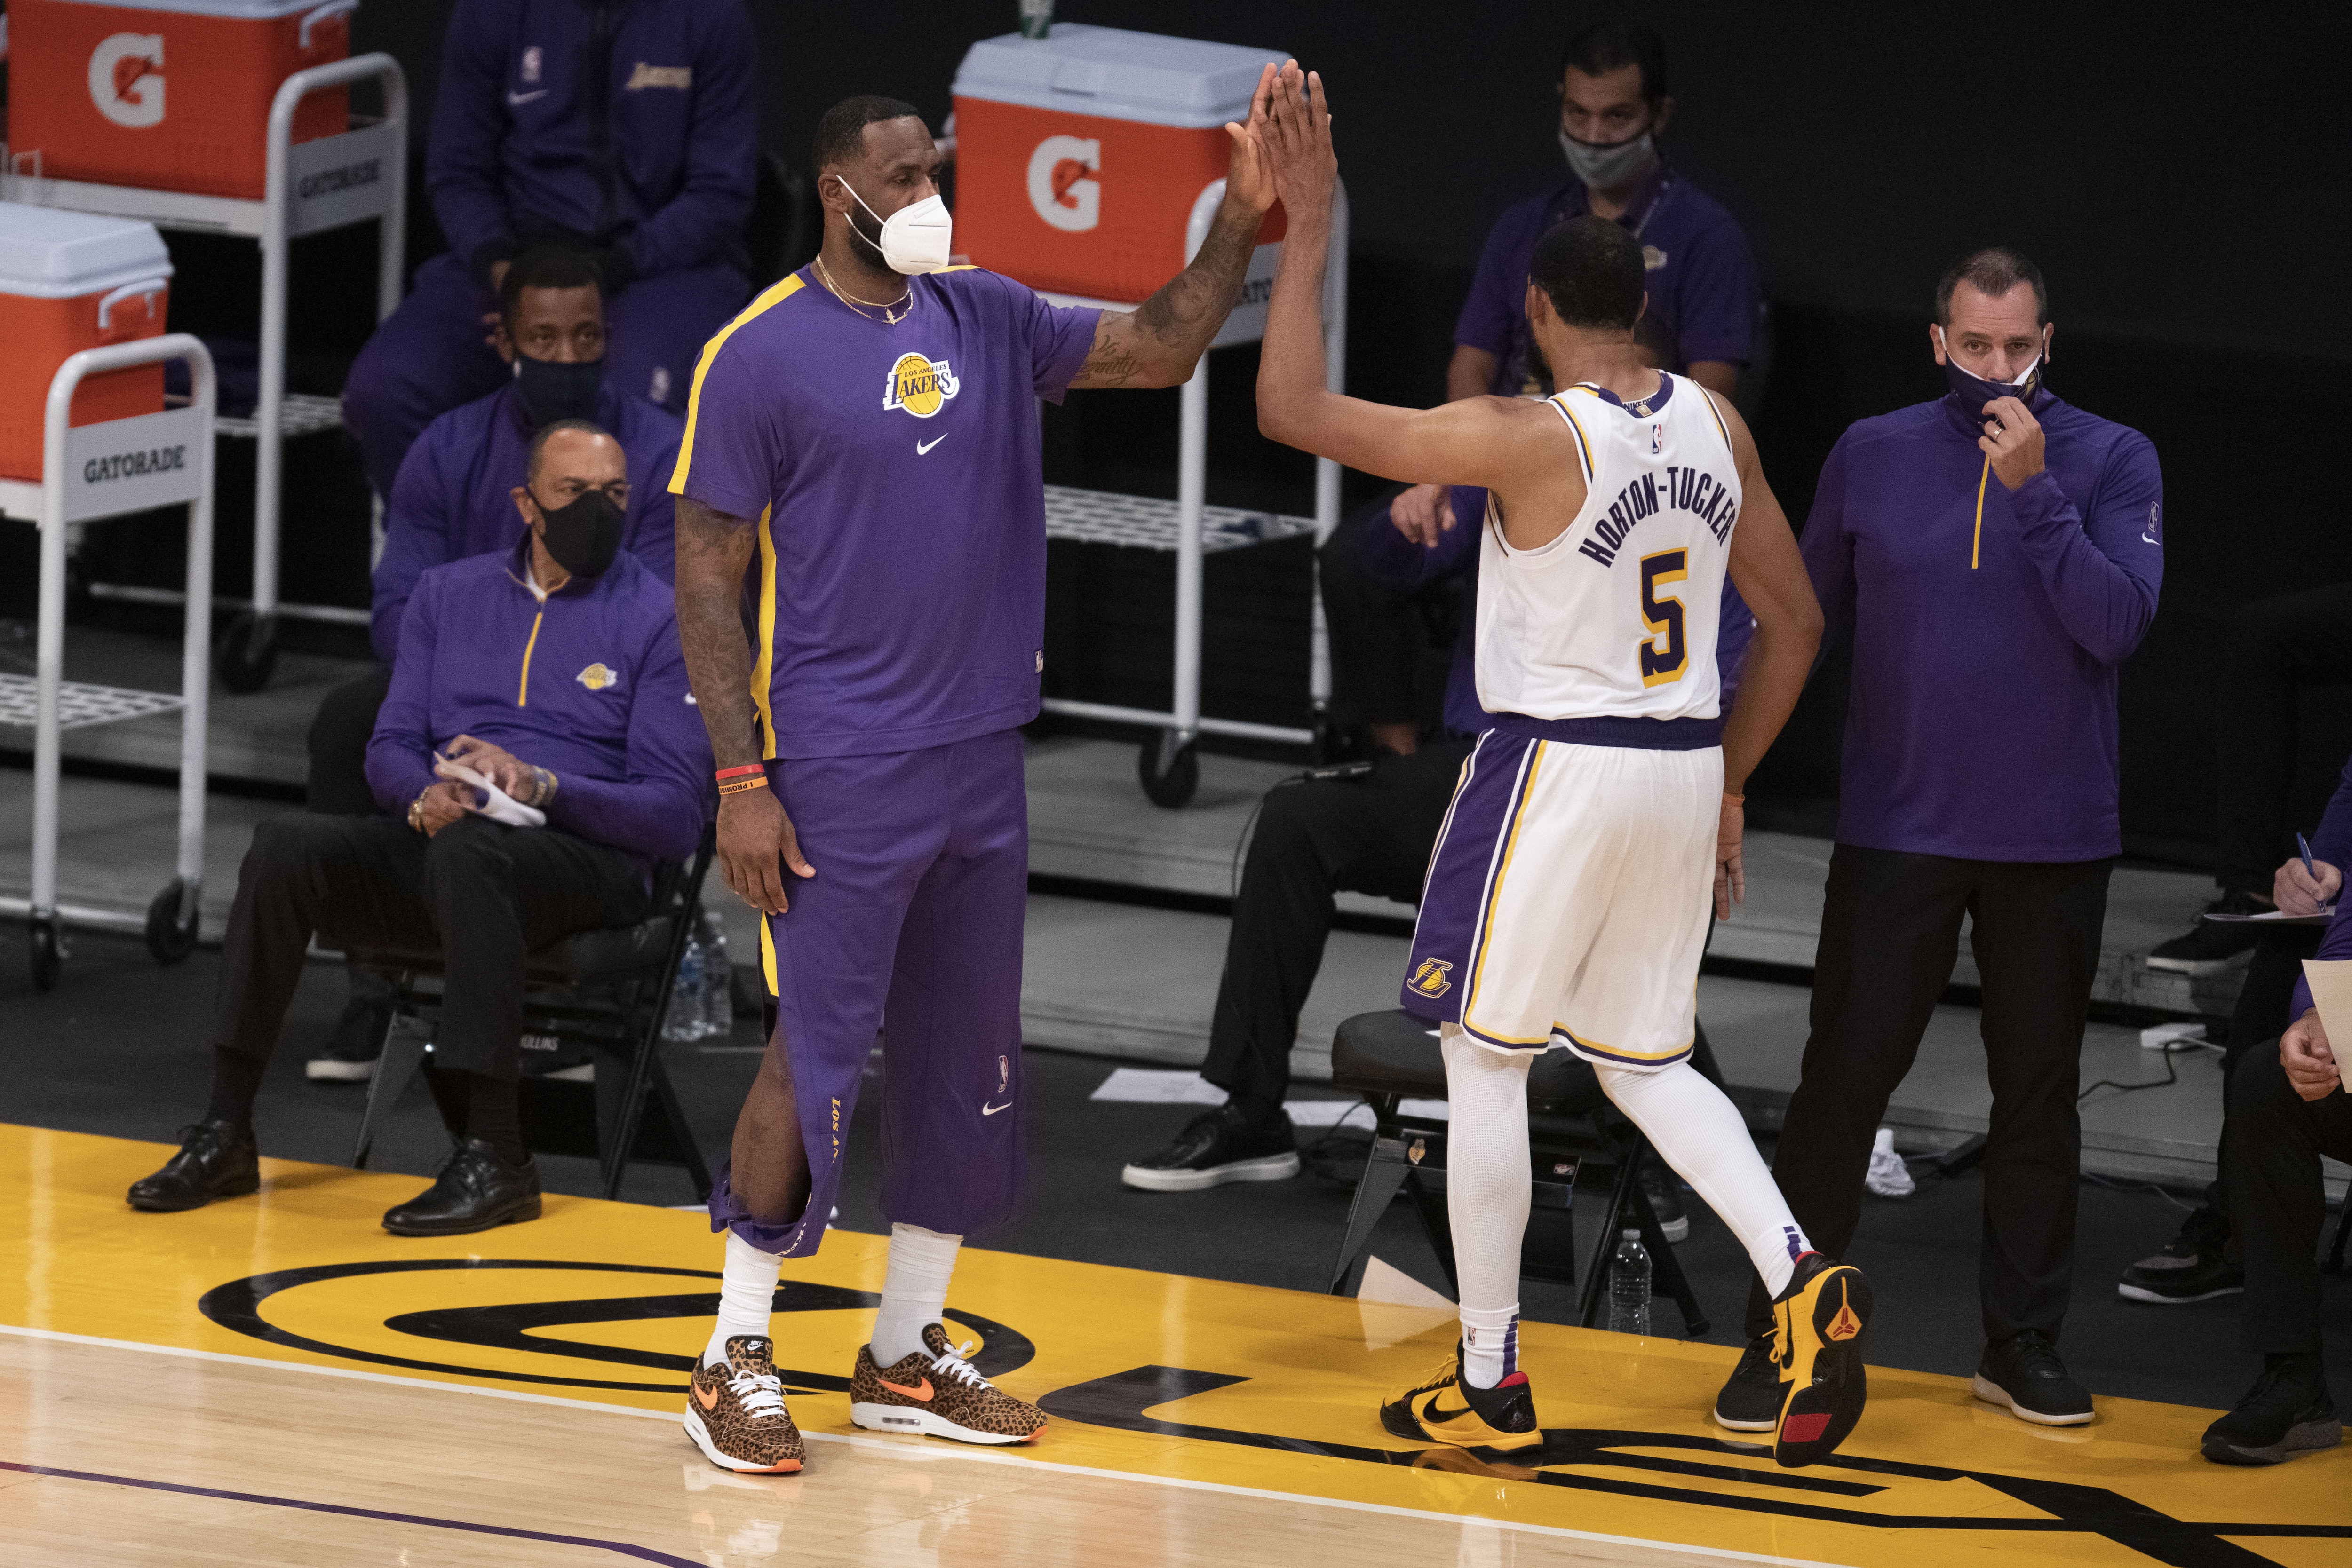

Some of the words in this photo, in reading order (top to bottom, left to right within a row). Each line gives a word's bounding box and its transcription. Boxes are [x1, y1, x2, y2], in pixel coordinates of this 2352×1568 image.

[88, 32, 165, 127] G
[1027, 135, 1100, 232] G
[888, 372, 956, 406] LAKERS
[918, 364, 947, 374] ANGELES
[84, 444, 186, 483] GATORADE
[1578, 467, 1736, 568] HORTON-TUCKER
[1640, 547, 1688, 688] 5
